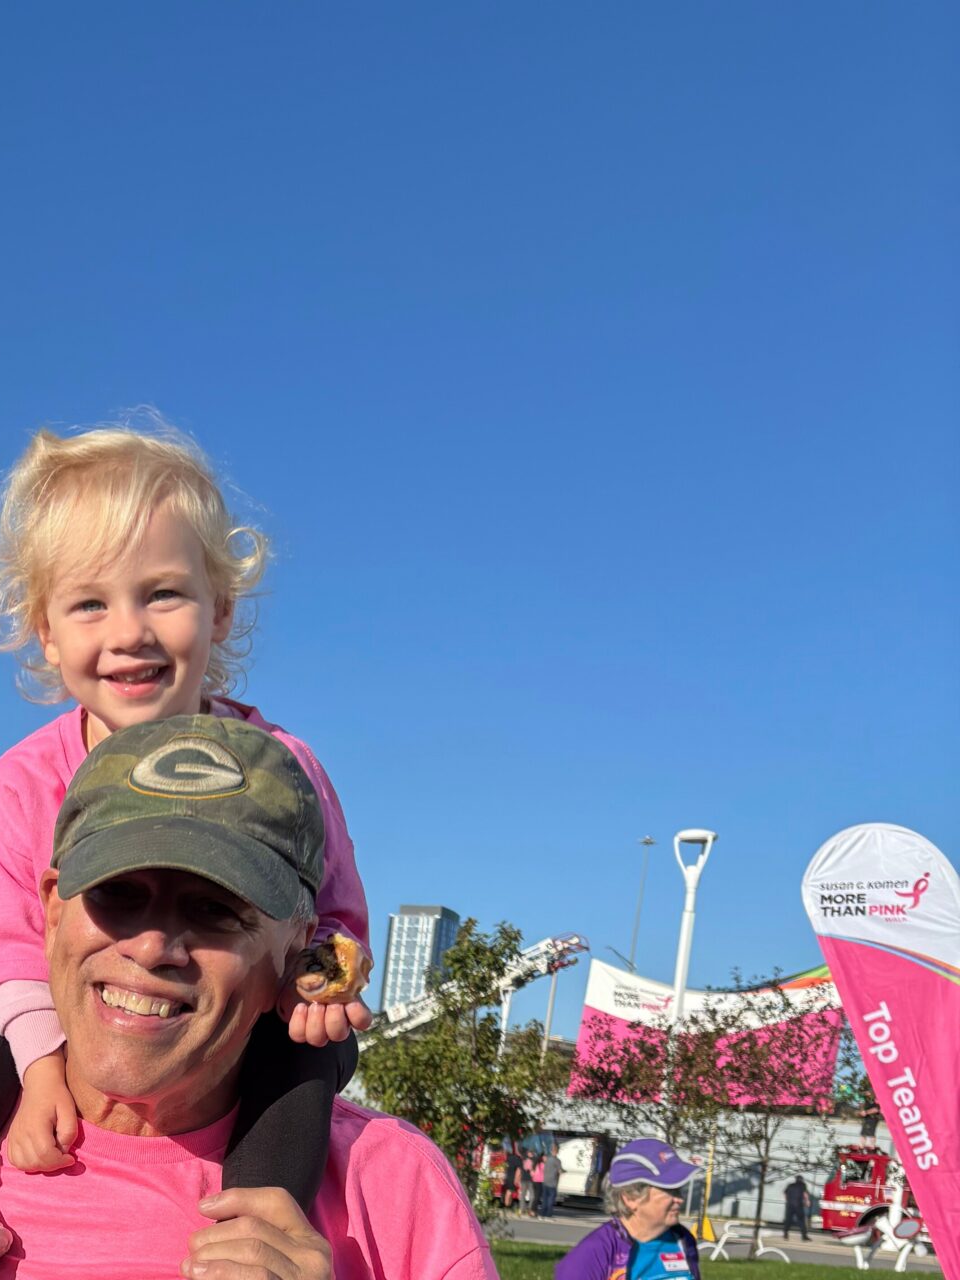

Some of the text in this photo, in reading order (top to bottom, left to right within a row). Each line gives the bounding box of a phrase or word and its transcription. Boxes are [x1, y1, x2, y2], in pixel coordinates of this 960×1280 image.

[130, 736, 245, 795] G
[820, 893, 867, 905] MORE
[821, 904, 908, 917] THAN PINK
[862, 1000, 940, 1172] Top Teams
